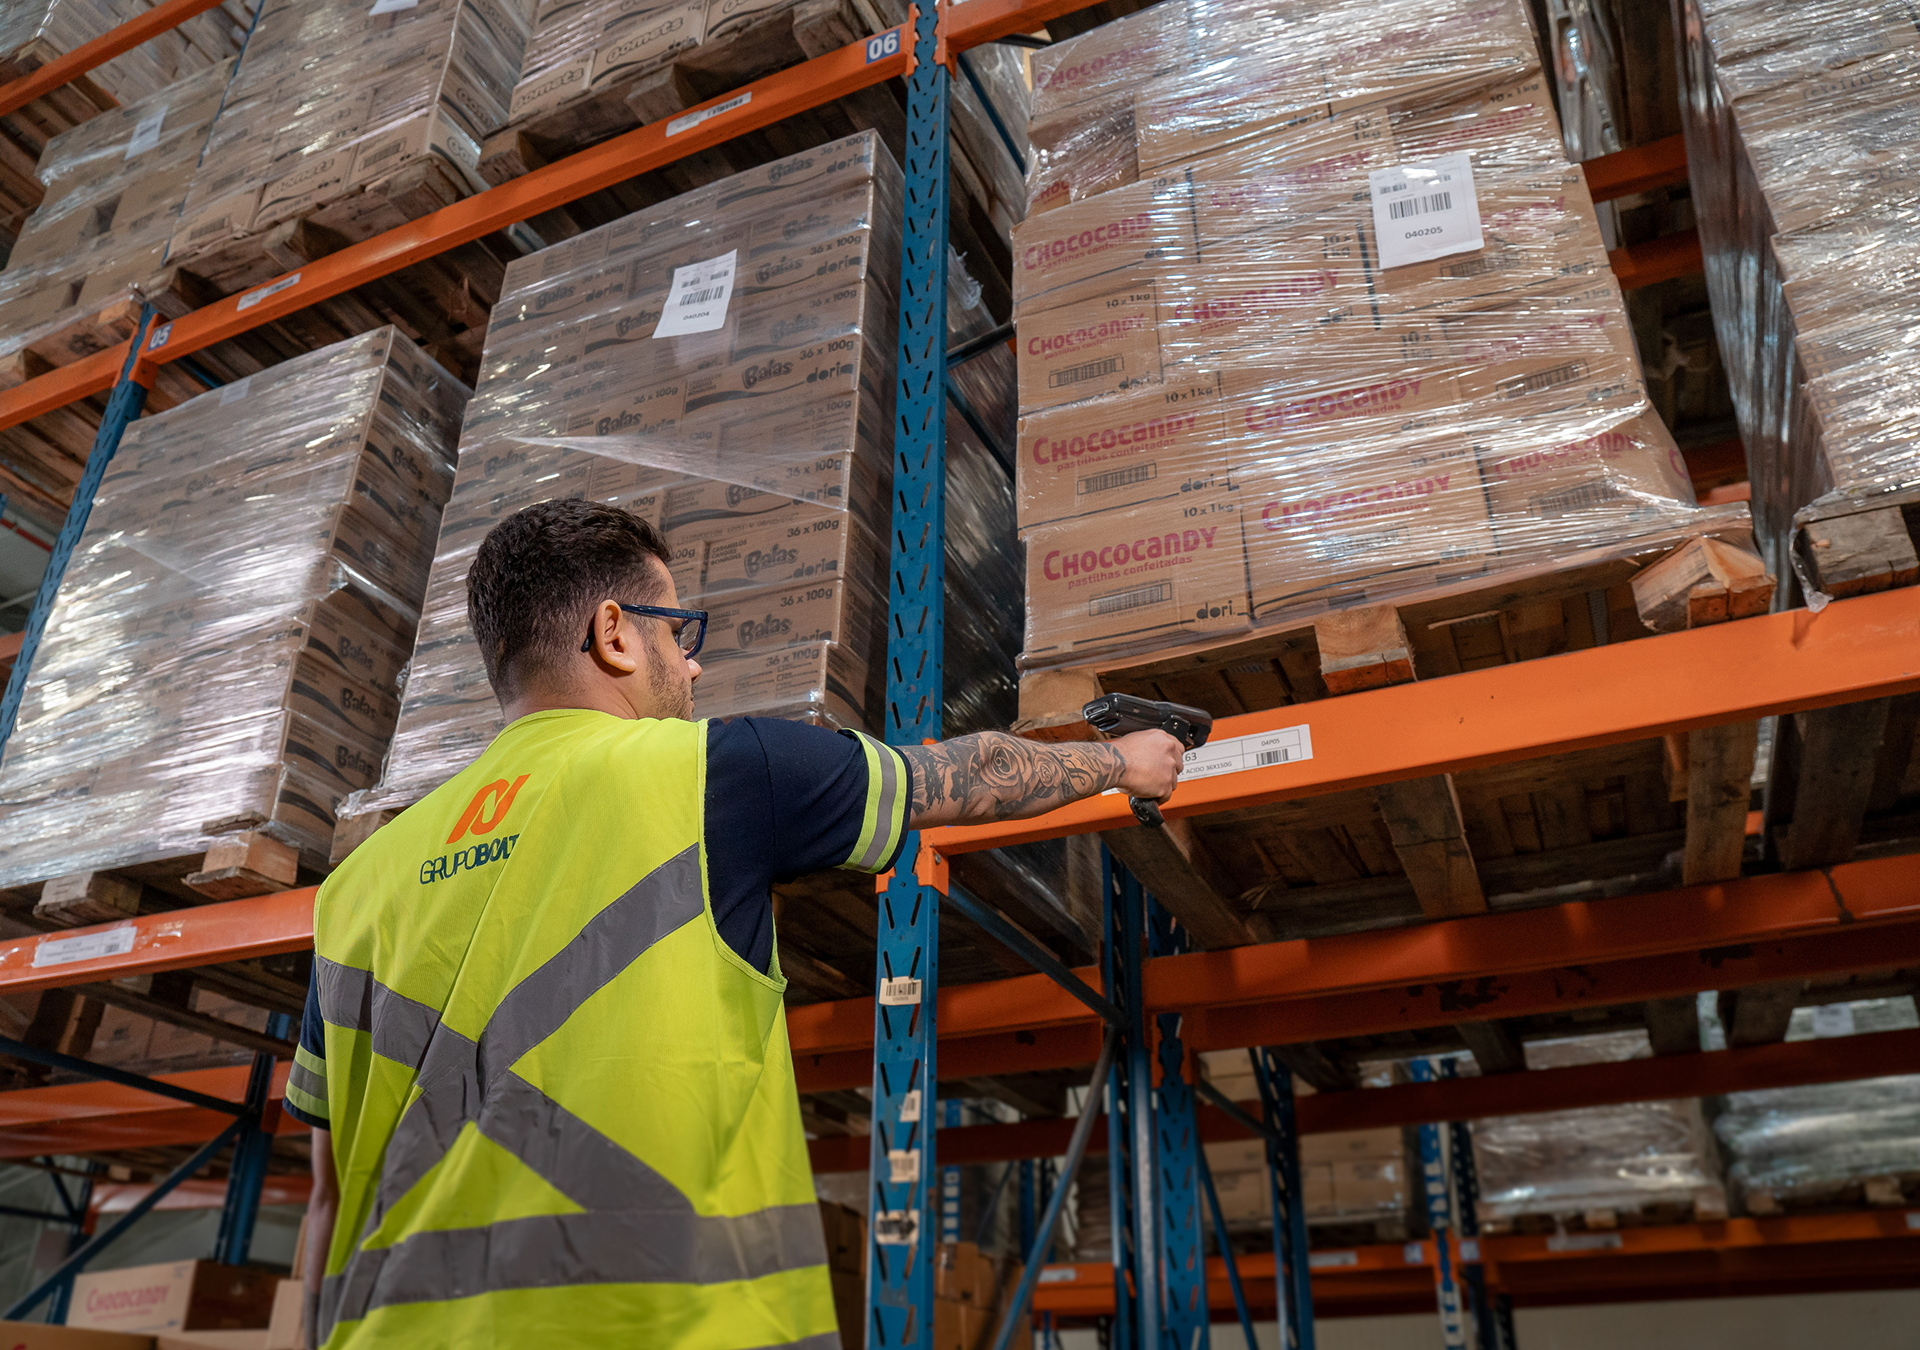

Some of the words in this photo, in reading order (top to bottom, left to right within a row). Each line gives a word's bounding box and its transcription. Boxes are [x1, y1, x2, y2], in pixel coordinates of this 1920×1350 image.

[868, 33, 898, 60] 06
[768, 156, 814, 183] Balas
[1404, 226, 1444, 240] 040205
[810, 245, 823, 255] 36
[837, 235, 862, 248] 100g
[756, 256, 804, 284] Balas
[1105, 298, 1120, 309] 10
[616, 309, 661, 337] Balas
[683, 311, 710, 321] 040204
[149, 325, 170, 349] 05
[800, 350, 814, 361] 36
[828, 339, 855, 352] 100g
[742, 358, 794, 390] Balas
[806, 361, 841, 384] dori
[1164, 392, 1179, 404] 10
[1181, 391, 1188, 400] x
[595, 410, 642, 437] Balas
[1057, 453, 1109, 473] pastilhas
[1110, 436, 1176, 460] confeitadas
[786, 466, 801, 479] 36
[815, 458, 843, 472] 100g
[725, 476, 779, 508] Balas
[1180, 473, 1215, 494] dori
[632, 496, 656, 508] 100g
[1182, 507, 1198, 518] 10
[1200, 506, 1207, 516] x
[787, 527, 801, 538] 36
[803, 525, 811, 534] x
[813, 518, 840, 533] 100g
[743, 543, 799, 578] Balas
[793, 557, 826, 578] dori
[1067, 569, 1121, 591] pastilhas
[1123, 556, 1194, 578] confeitadas
[780, 596, 793, 608] 36
[796, 595, 804, 603] x
[806, 587, 833, 602] 100g
[1196, 600, 1234, 620] dori
[737, 613, 793, 650] Balas
[765, 656, 780, 668] 36
[792, 648, 820, 662] 100g
[1261, 738, 1281, 747] 04P05
[1185, 766, 1205, 775] ACIDO
[1205, 761, 1233, 771] 36X150G
